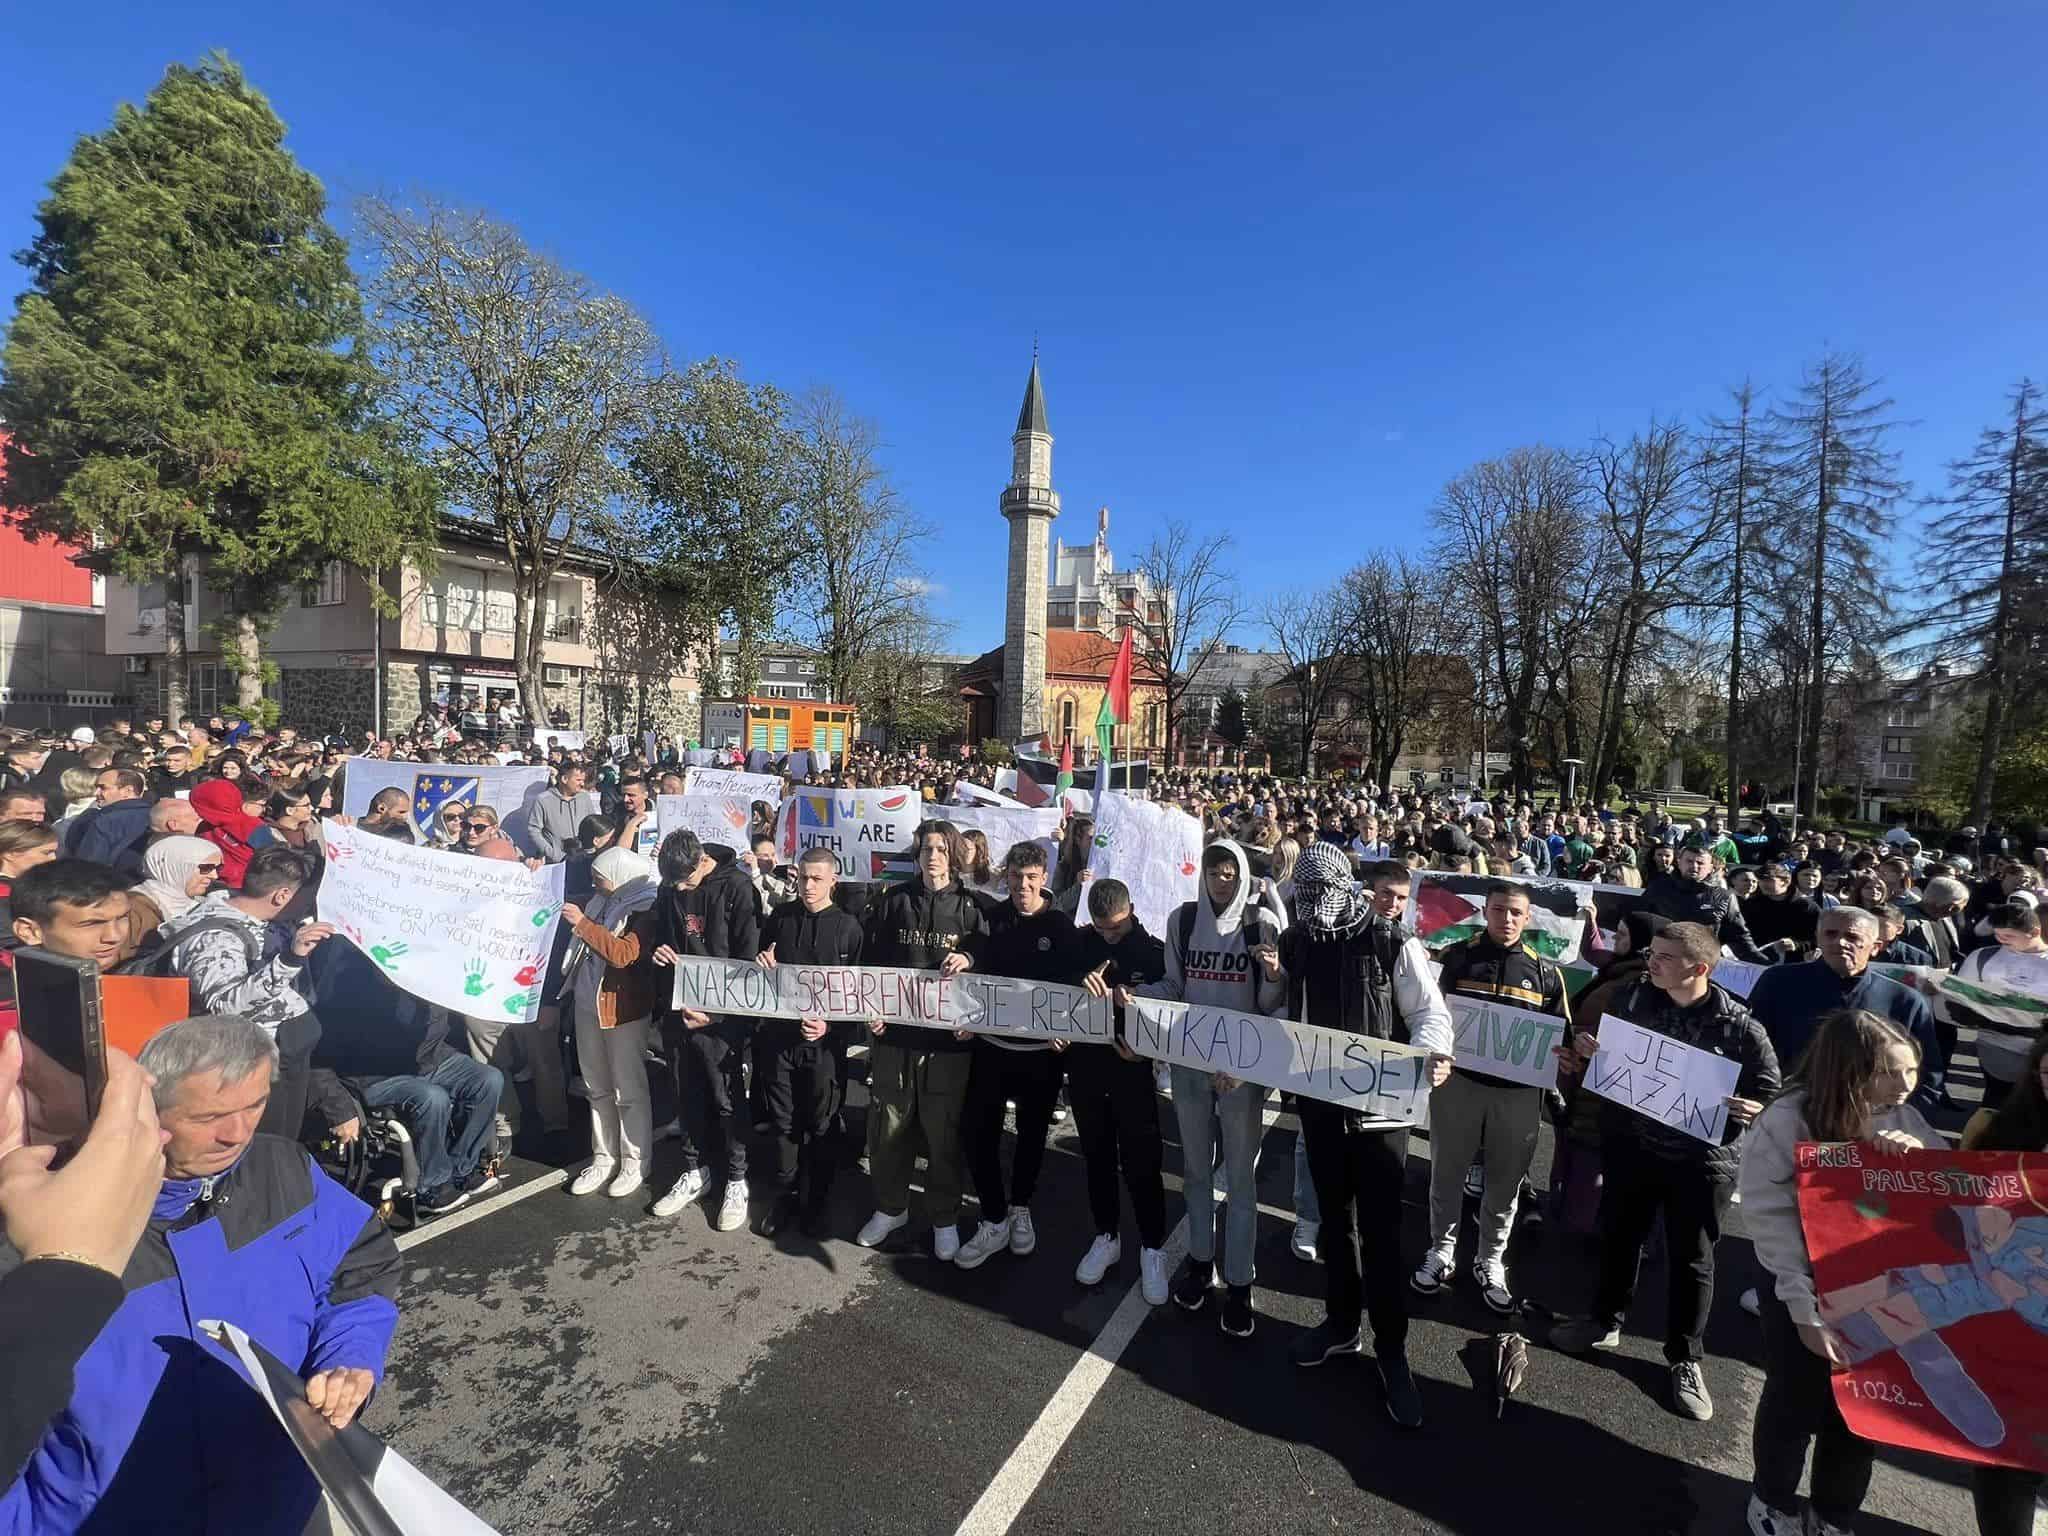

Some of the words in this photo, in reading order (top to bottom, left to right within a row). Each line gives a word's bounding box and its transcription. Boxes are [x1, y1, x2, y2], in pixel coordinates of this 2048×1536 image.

[838, 798, 865, 820] WE
[799, 832, 843, 852] WITH
[857, 823, 896, 843] ARE
[429, 911, 457, 928] you
[399, 919, 428, 937] ON
[445, 927, 472, 946] YOU
[1185, 950, 1221, 970] JUST
[1222, 951, 1249, 973] DO
[682, 963, 779, 1013] NAKON
[967, 981, 1013, 1028] STE
[1031, 986, 1108, 1035] REKLI
[1135, 1007, 1263, 1070] NIKAD
[1294, 1031, 1425, 1115] VIŠE!
[1625, 1029, 1687, 1080] JE
[1799, 1144, 1863, 1169] FREE
[1862, 1167, 2024, 1200] PALESTINE
